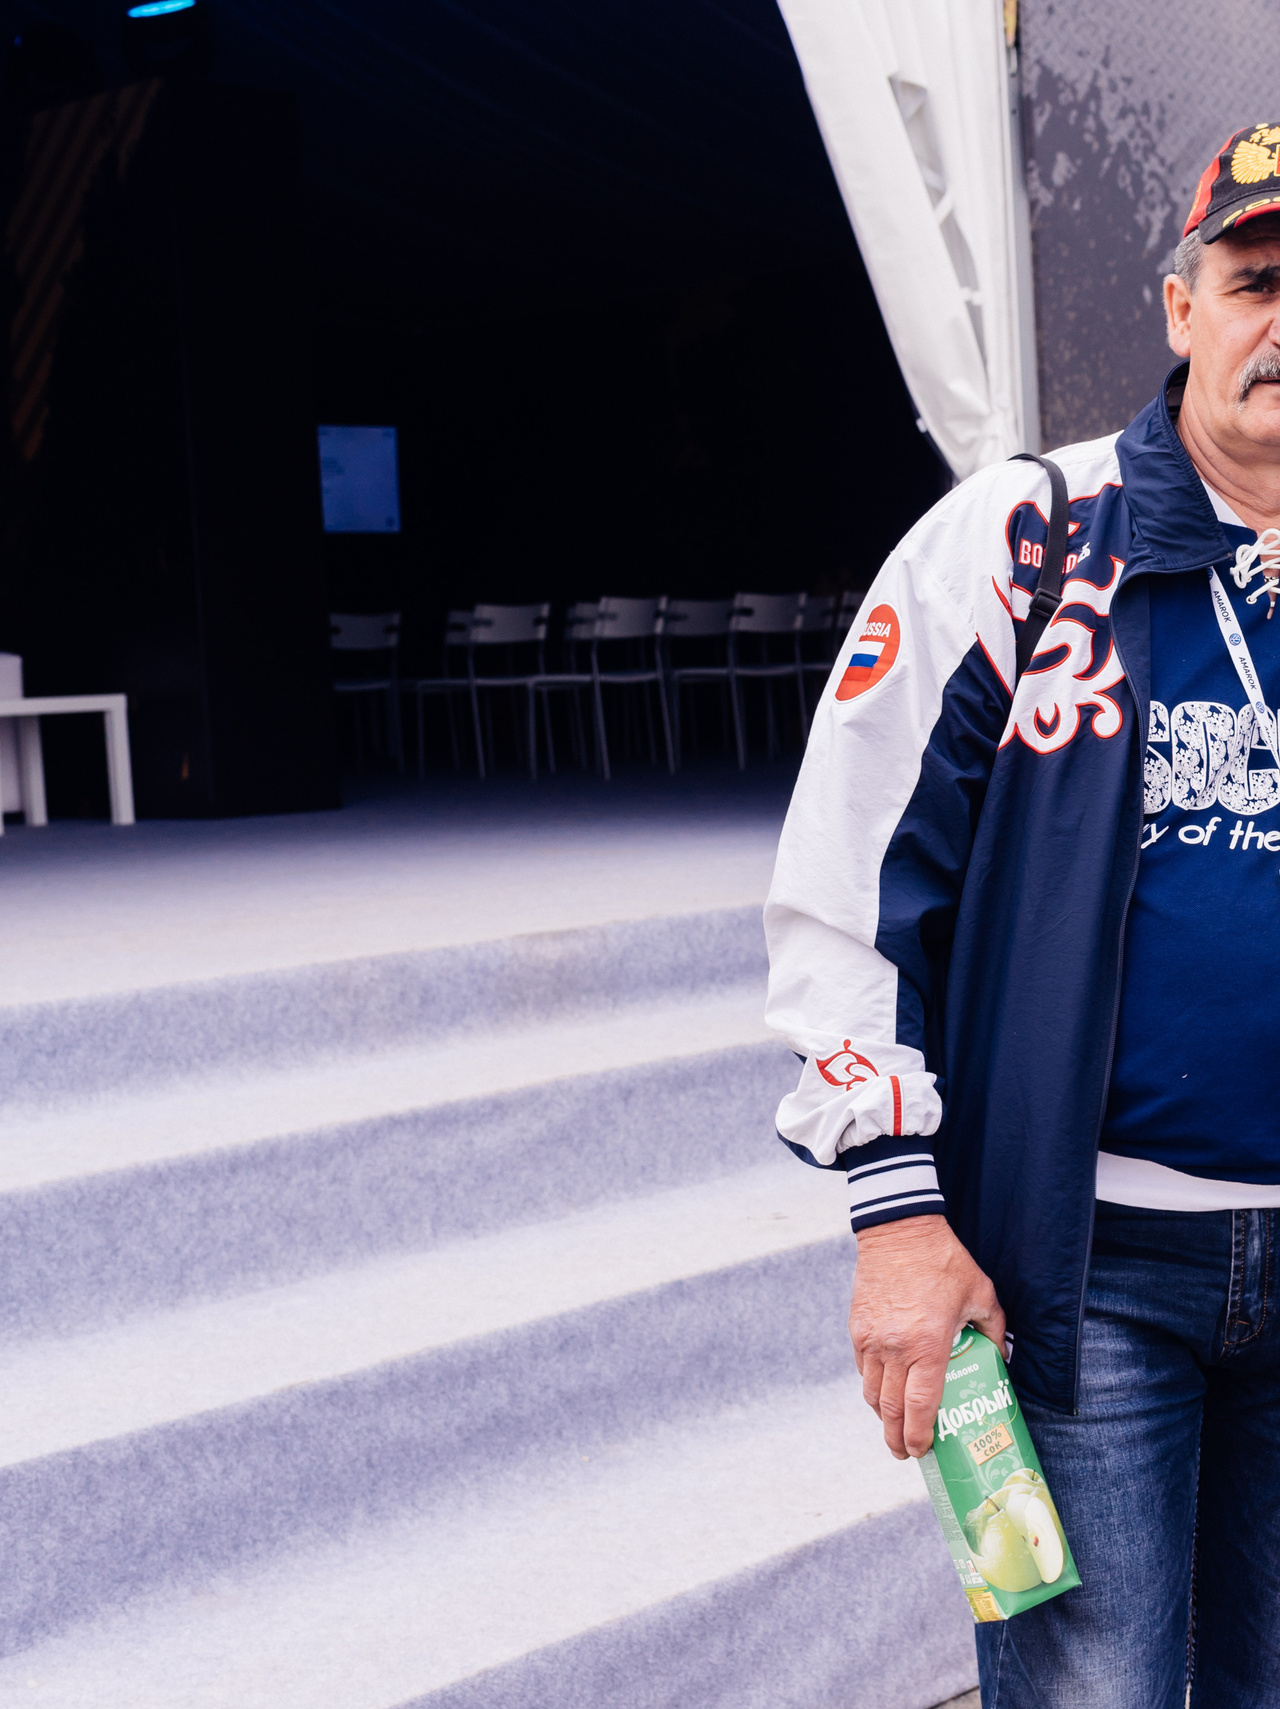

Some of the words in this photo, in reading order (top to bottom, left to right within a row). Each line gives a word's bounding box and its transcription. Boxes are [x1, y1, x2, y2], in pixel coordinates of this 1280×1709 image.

[1213, 590, 1232, 623] AMAROK
[863, 621, 892, 638] USSIA
[1239, 656, 1257, 690] AMAROK
[1178, 817, 1222, 846] of
[945, 1363, 979, 1383] Яблоко
[973, 1429, 1002, 1452] 100%
